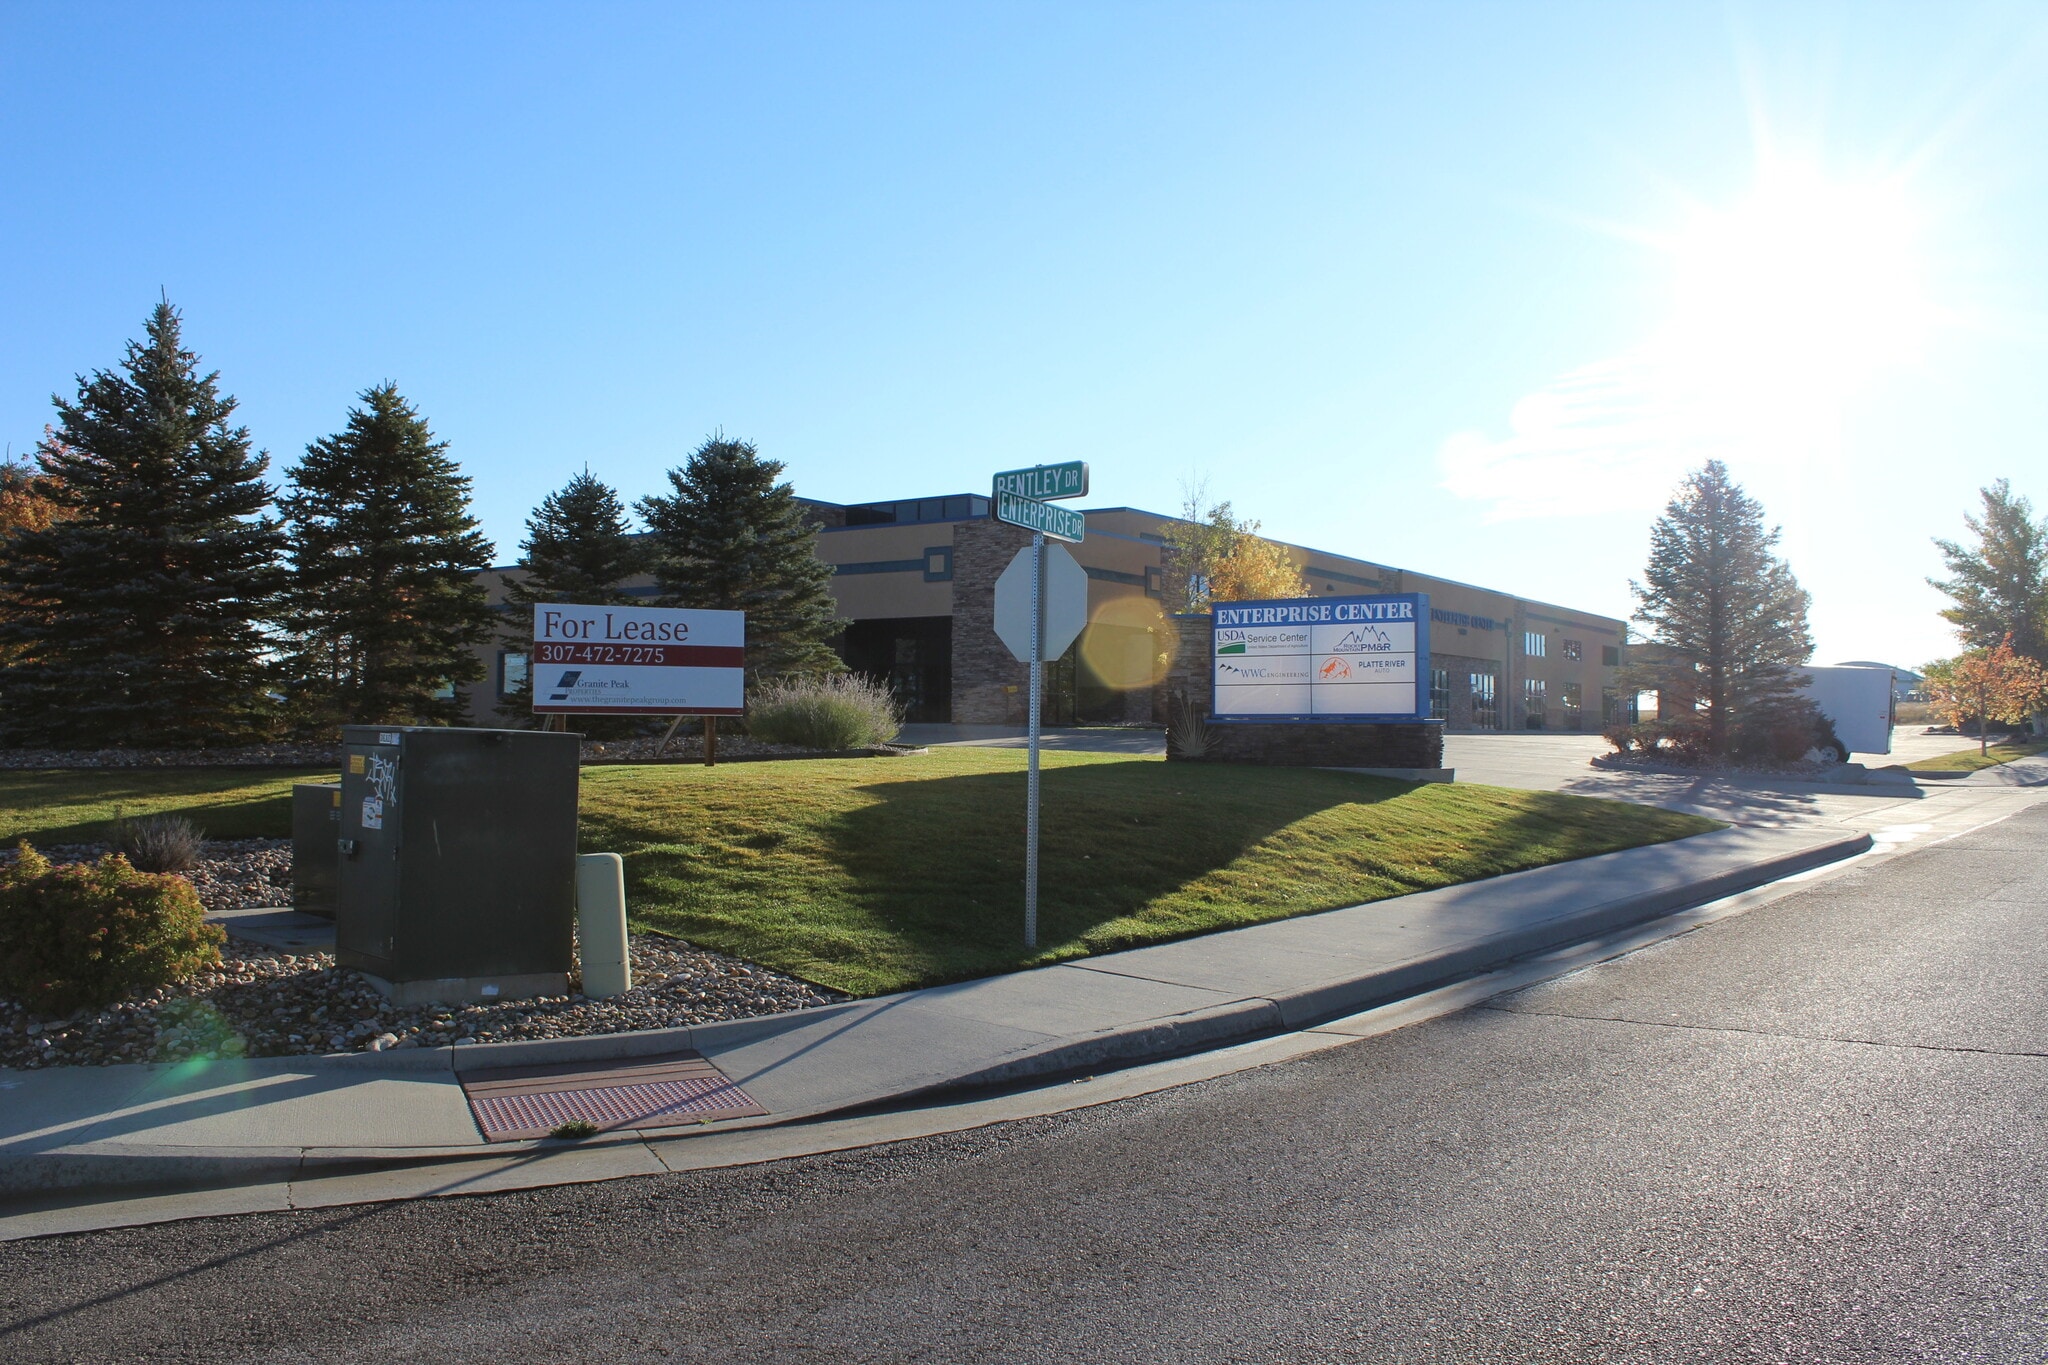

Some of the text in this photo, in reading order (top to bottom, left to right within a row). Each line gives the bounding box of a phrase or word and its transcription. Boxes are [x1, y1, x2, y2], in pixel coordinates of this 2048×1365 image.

[997, 468, 1078, 496] BENTLEY DR
[1001, 493, 1083, 537] ENTERPRISE DR
[1217, 602, 1413, 625] ENTERPRISE CENTER
[544, 611, 689, 641] For Lease
[1218, 630, 1245, 641] USDA
[1247, 633, 1308, 643] Service Center
[1361, 643, 1391, 652] PM&R
[542, 645, 664, 663] 307-472-7275
[1241, 668, 1266, 678] WWC
[577, 680, 629, 688] Granite Peak
[570, 696, 687, 705] www.thegranitepeakgroup.com
